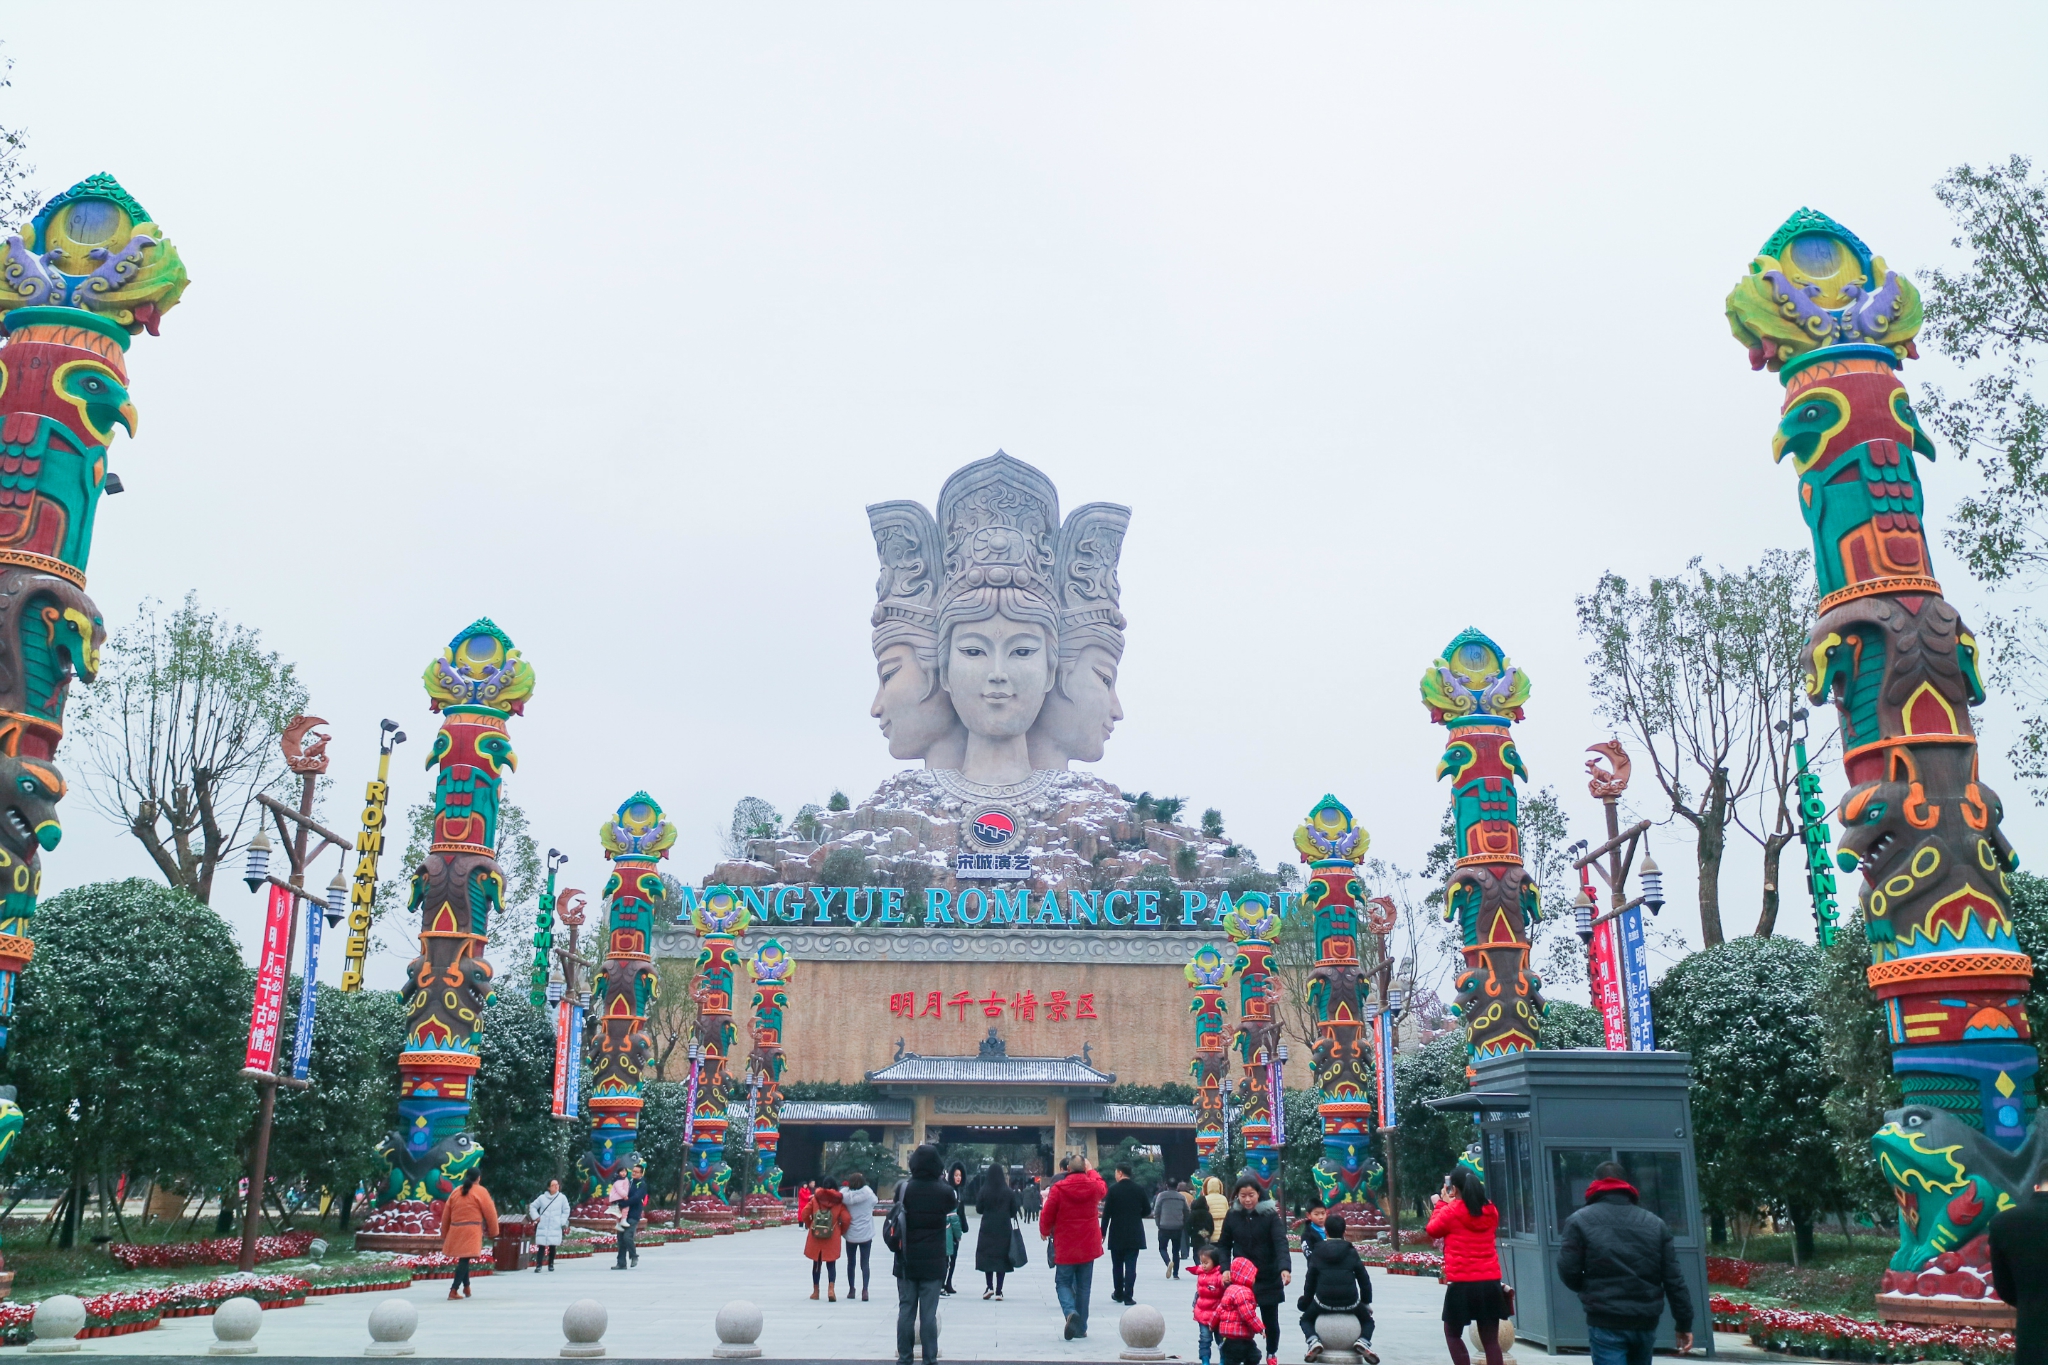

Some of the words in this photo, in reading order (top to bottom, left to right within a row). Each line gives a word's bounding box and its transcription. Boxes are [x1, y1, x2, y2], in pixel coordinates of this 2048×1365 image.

[957, 854, 1030, 870] 宋城演艺
[1802, 774, 1840, 946] ROMANCE
[676, 885, 905, 924] MNGYUE
[924, 887, 1161, 926] ROMANCE
[263, 953, 285, 1052] 一生必看的演出
[889, 989, 1098, 1022] 明月千古情景区
